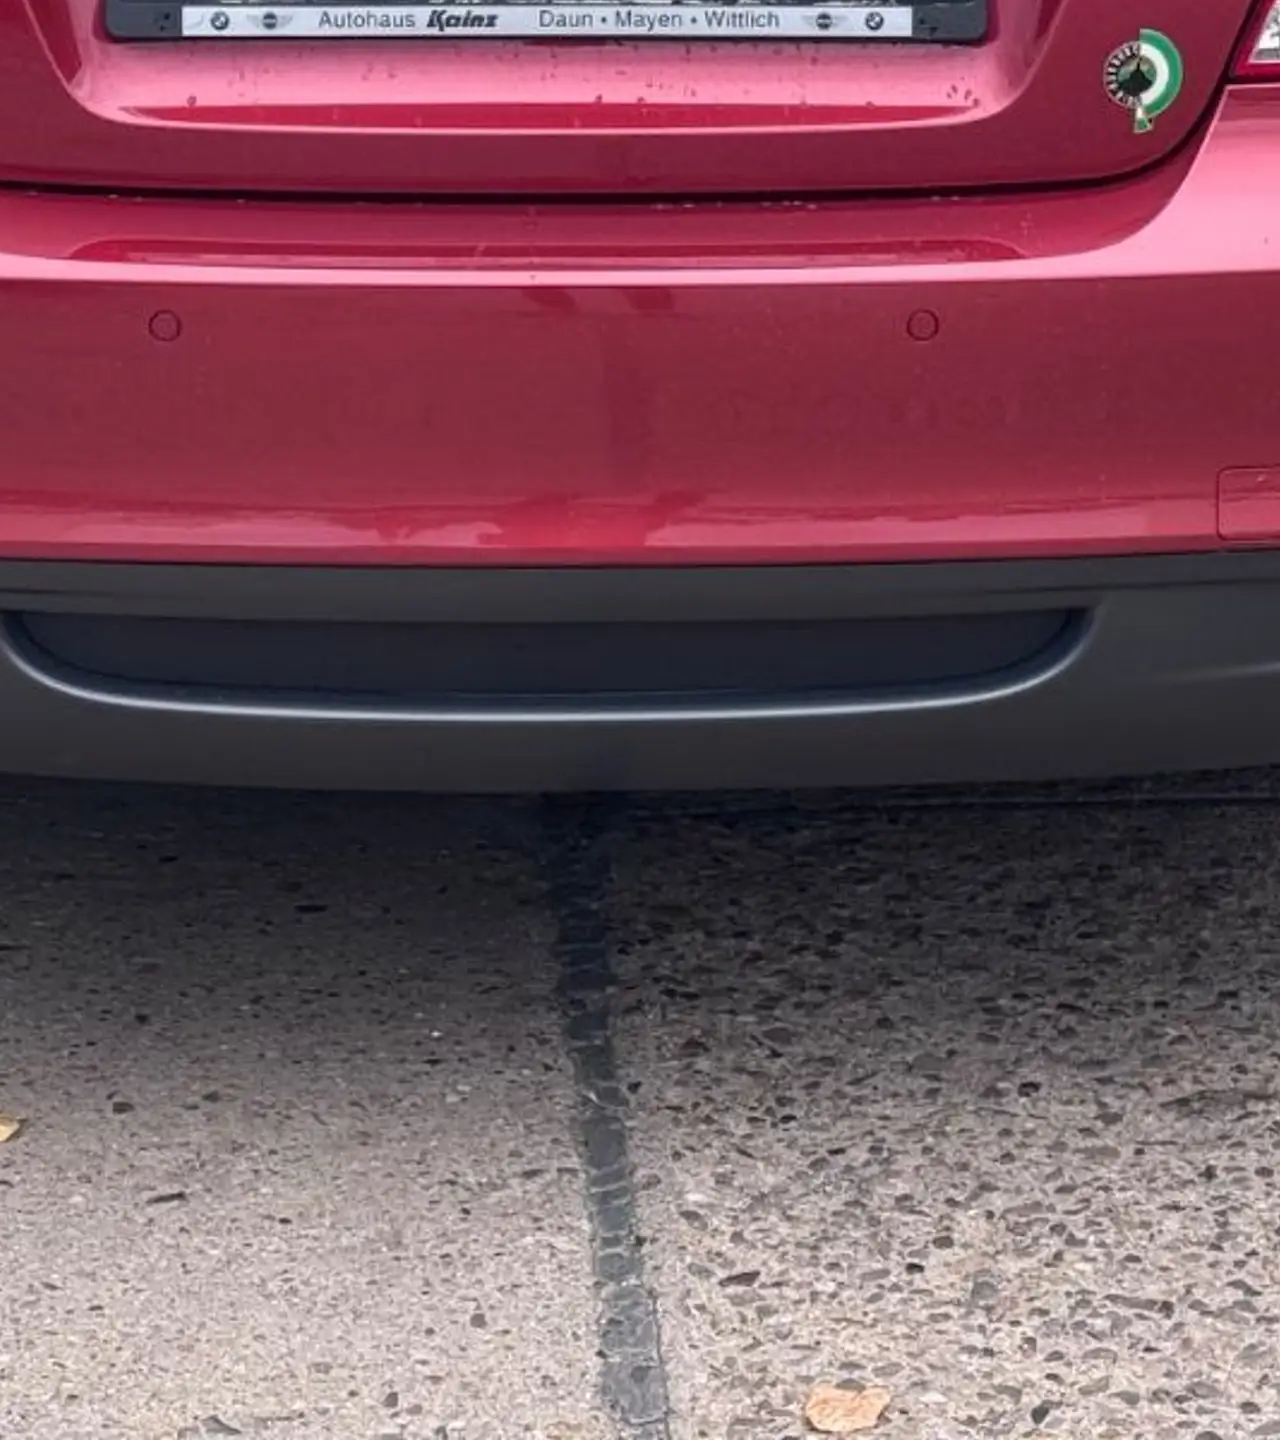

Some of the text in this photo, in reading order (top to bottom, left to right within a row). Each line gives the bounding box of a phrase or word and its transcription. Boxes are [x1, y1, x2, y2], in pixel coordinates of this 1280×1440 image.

[318, 9, 780, 32] Autohaus Kainz Daun Mayen Wittlich
